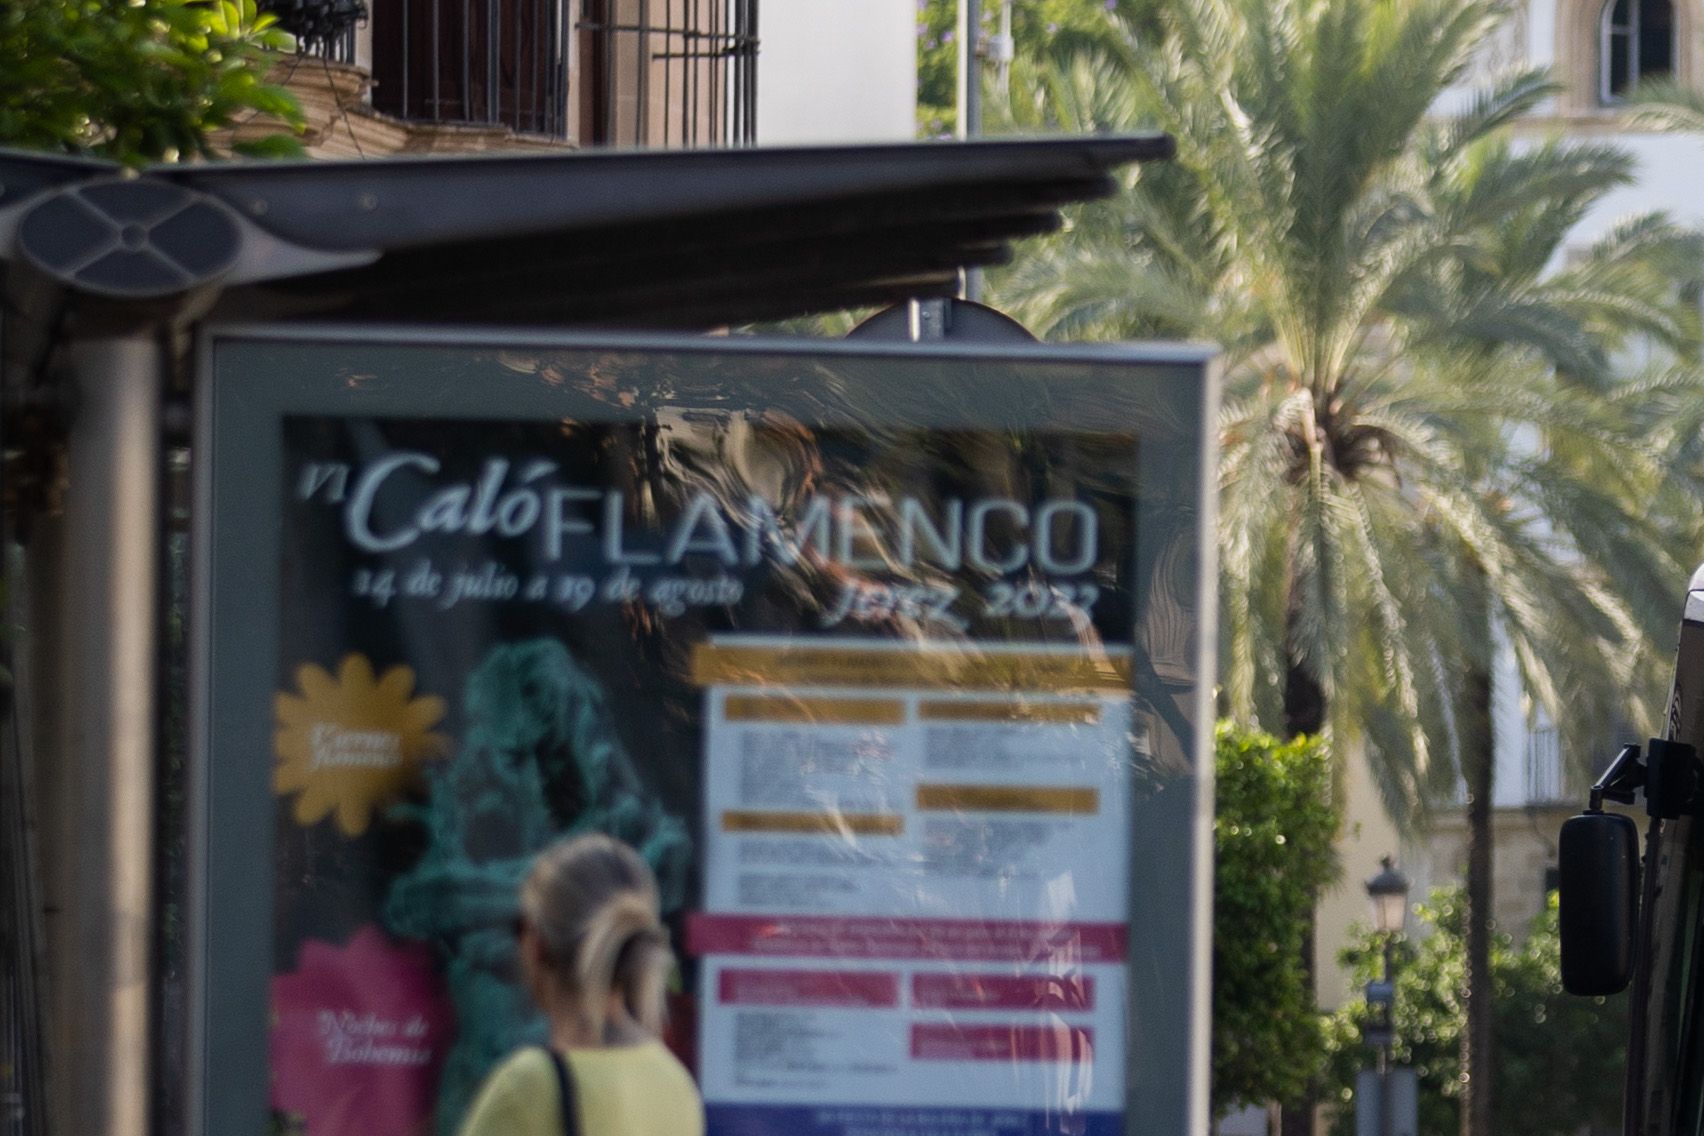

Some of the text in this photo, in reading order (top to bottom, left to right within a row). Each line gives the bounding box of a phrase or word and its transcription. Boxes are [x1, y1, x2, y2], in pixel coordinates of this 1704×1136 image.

[346, 451, 558, 553] Caló
[545, 488, 1098, 576] FLAMENCO
[405, 560, 442, 598] de
[440, 562, 519, 609] julio
[526, 574, 549, 600] a
[605, 566, 641, 602] de
[650, 576, 744, 617] agosto
